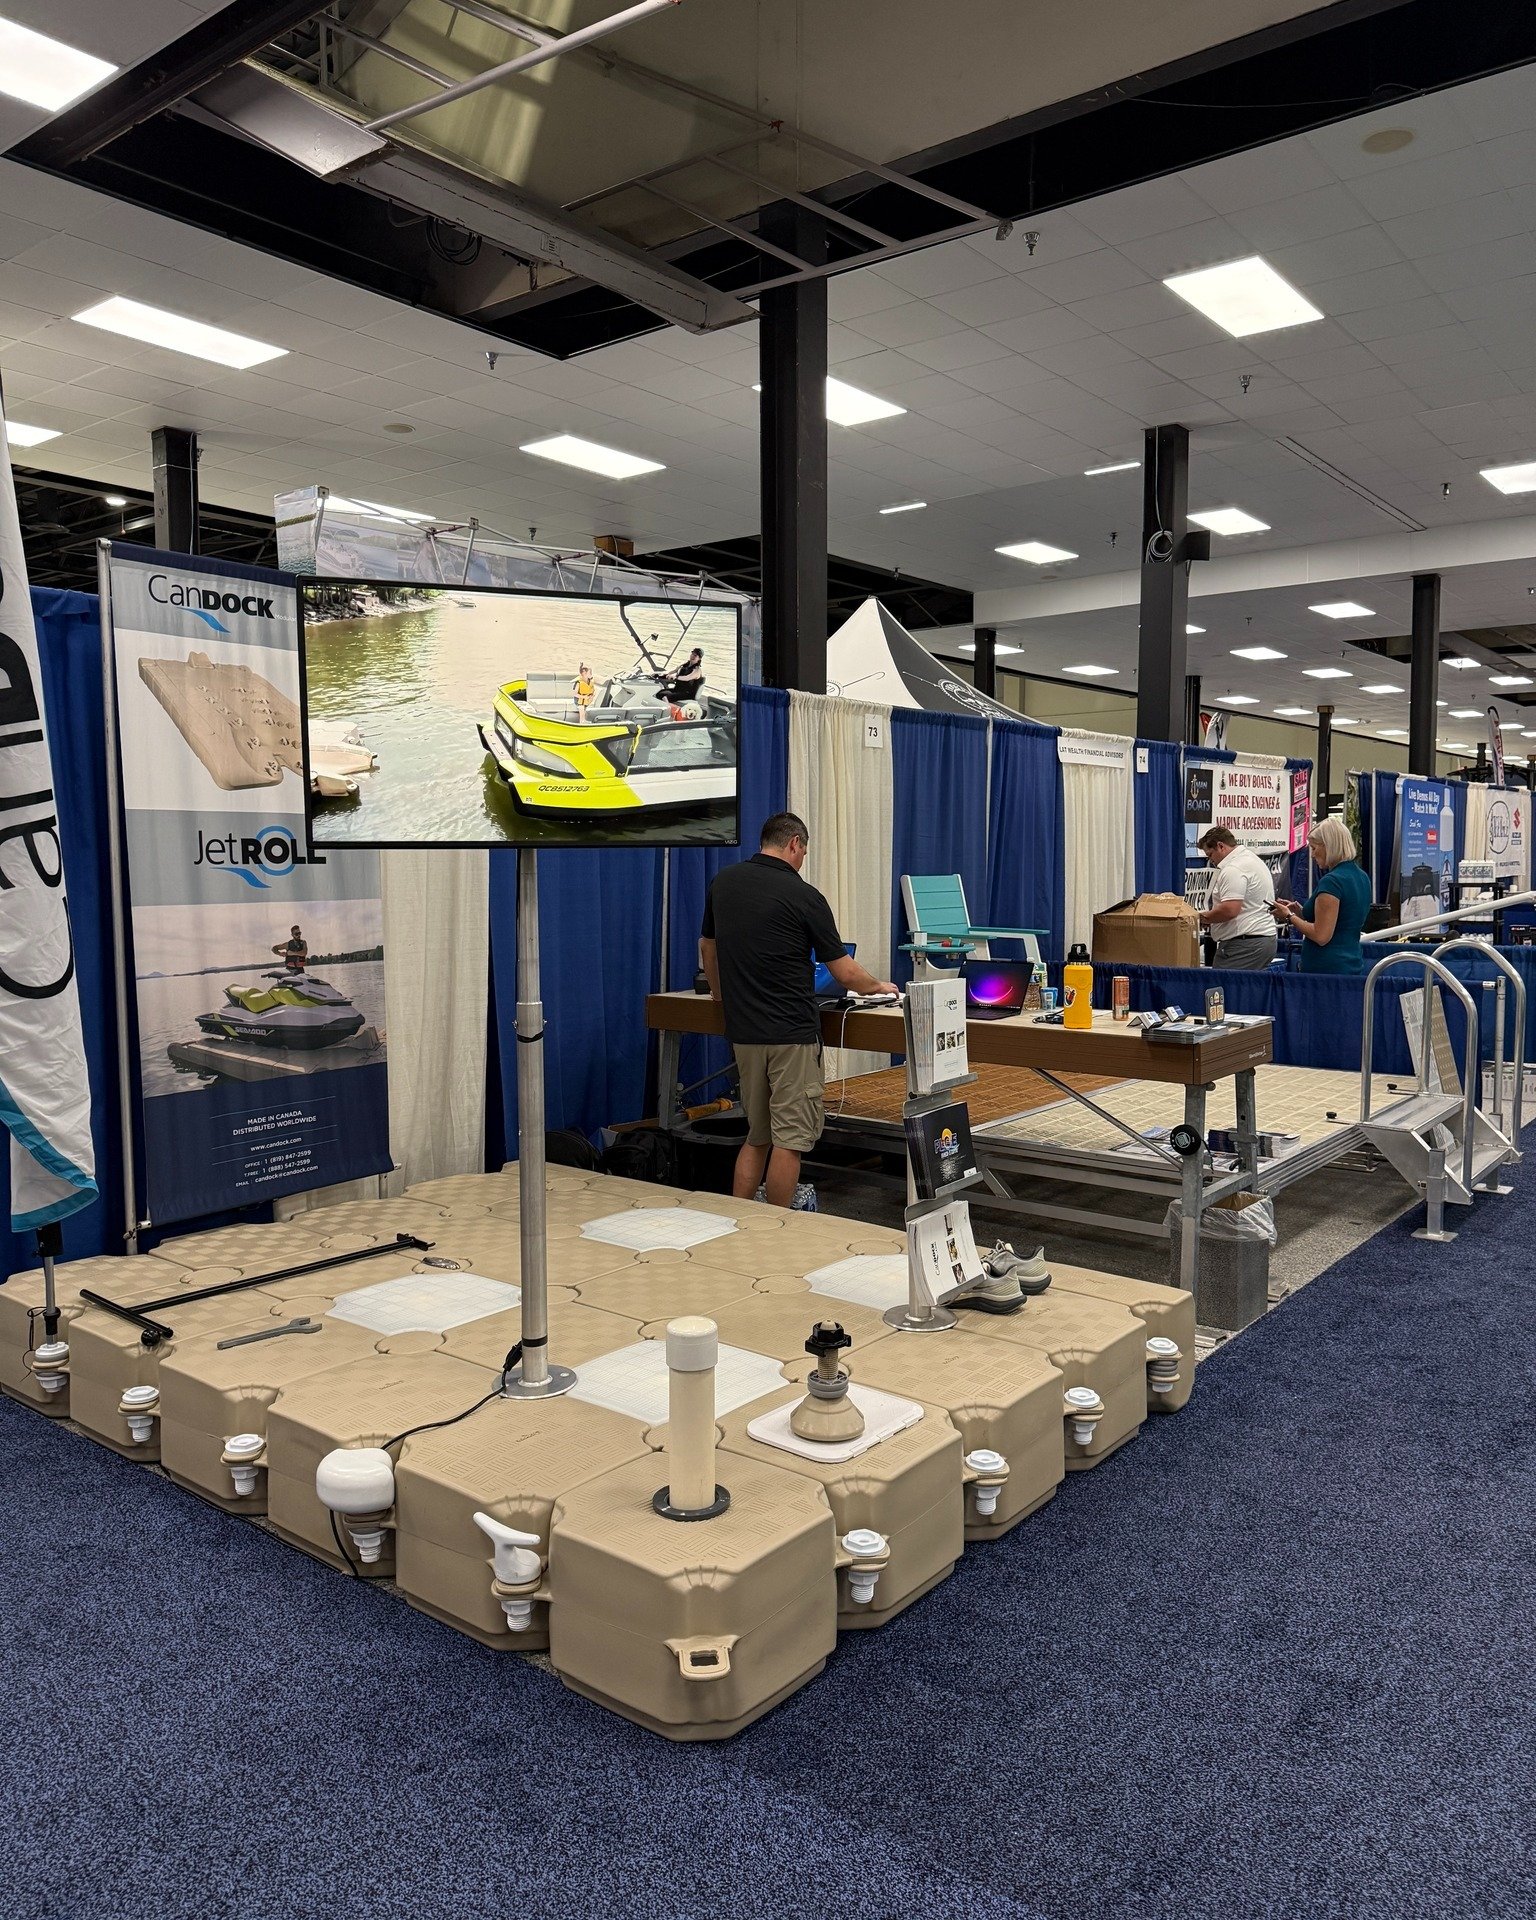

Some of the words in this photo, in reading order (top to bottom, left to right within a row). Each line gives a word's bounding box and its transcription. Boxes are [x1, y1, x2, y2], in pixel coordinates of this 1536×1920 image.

[148, 574, 275, 620] CanDOCK
[868, 726, 878, 738] 73
[1068, 747, 1084, 755] WEALTH
[1084, 749, 1104, 757] FINANCIAL
[1104, 751, 1124, 759] ADVISORS
[1139, 756, 1146, 764] 74
[1228, 773, 1238, 787] WE
[1239, 774, 1251, 788] BUY
[1186, 799, 1210, 812] BOATS
[1218, 794, 1250, 810] TRAILERS,
[1252, 796, 1275, 810] ENGINES
[1276, 798, 1280, 810] &
[1216, 816, 1240, 830] MARINE
[1242, 817, 1282, 830] ACCESSORIES
[194, 830, 326, 865] JetROLL
[247, 1116, 266, 1126] MADE
[276, 1110, 302, 1120] CANADA
[232, 1123, 276, 1136] DISTRIBUTED
[277, 1116, 317, 1128] WORLDWIDE
[250, 1136, 302, 1152] www.candock.com
[285, 1150, 312, 1160] 847-2599
[284, 1158, 311, 1169] 547-2599
